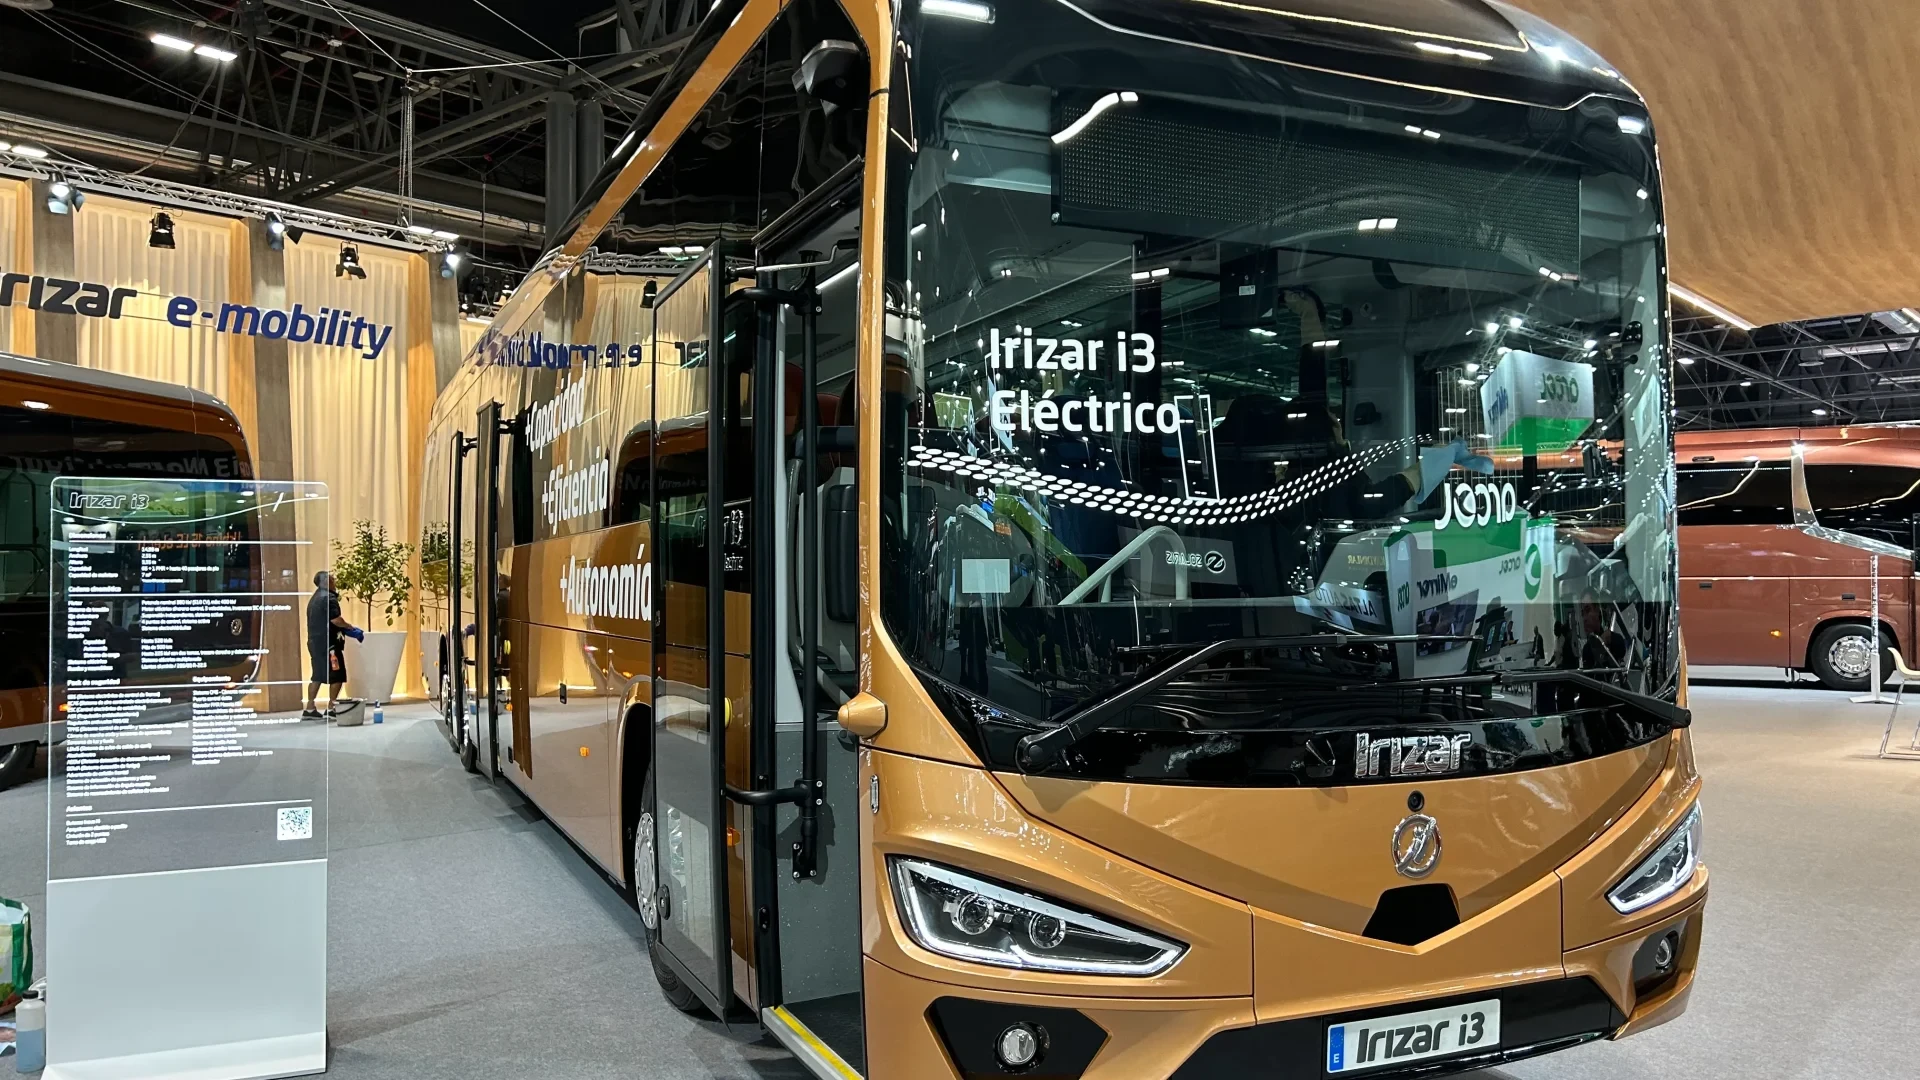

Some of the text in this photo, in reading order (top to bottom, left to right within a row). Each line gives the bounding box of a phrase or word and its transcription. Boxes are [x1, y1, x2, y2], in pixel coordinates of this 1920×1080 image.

[0, 270, 393, 359] rizar e-mobility
[990, 328, 1155, 373] Irizar i3
[991, 388, 1180, 434] Eléctrico
[69, 492, 149, 510] Irizar i3
[1355, 732, 1471, 776] Irizar
[1333, 1011, 1486, 1064] Irizar i3 E
